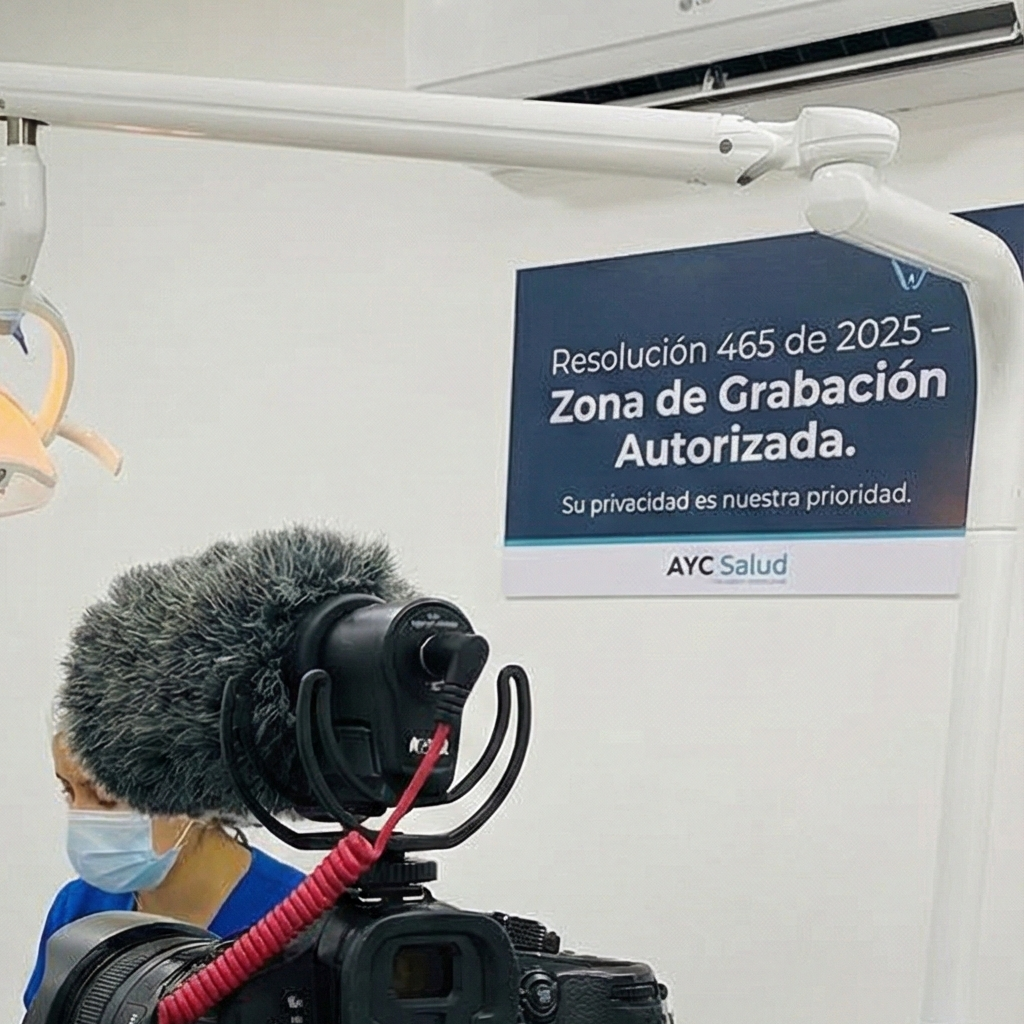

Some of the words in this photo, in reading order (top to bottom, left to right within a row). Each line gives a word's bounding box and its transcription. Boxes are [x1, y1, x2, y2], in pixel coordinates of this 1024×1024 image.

[552, 335, 706, 375] Resolución
[717, 329, 775, 360] 465
[785, 325, 826, 355] de
[837, 315, 922, 351] 2025
[549, 389, 644, 424] Zona
[656, 379, 707, 416] de
[719, 359, 947, 412] Grabación
[614, 420, 856, 468] Autorizada.
[562, 496, 585, 514] Su
[591, 490, 690, 518] privacidad
[695, 494, 717, 509] es
[722, 490, 800, 509] nuestra
[806, 481, 912, 511] prioridad.
[666, 556, 714, 576] AYC
[720, 553, 788, 575] Salud
